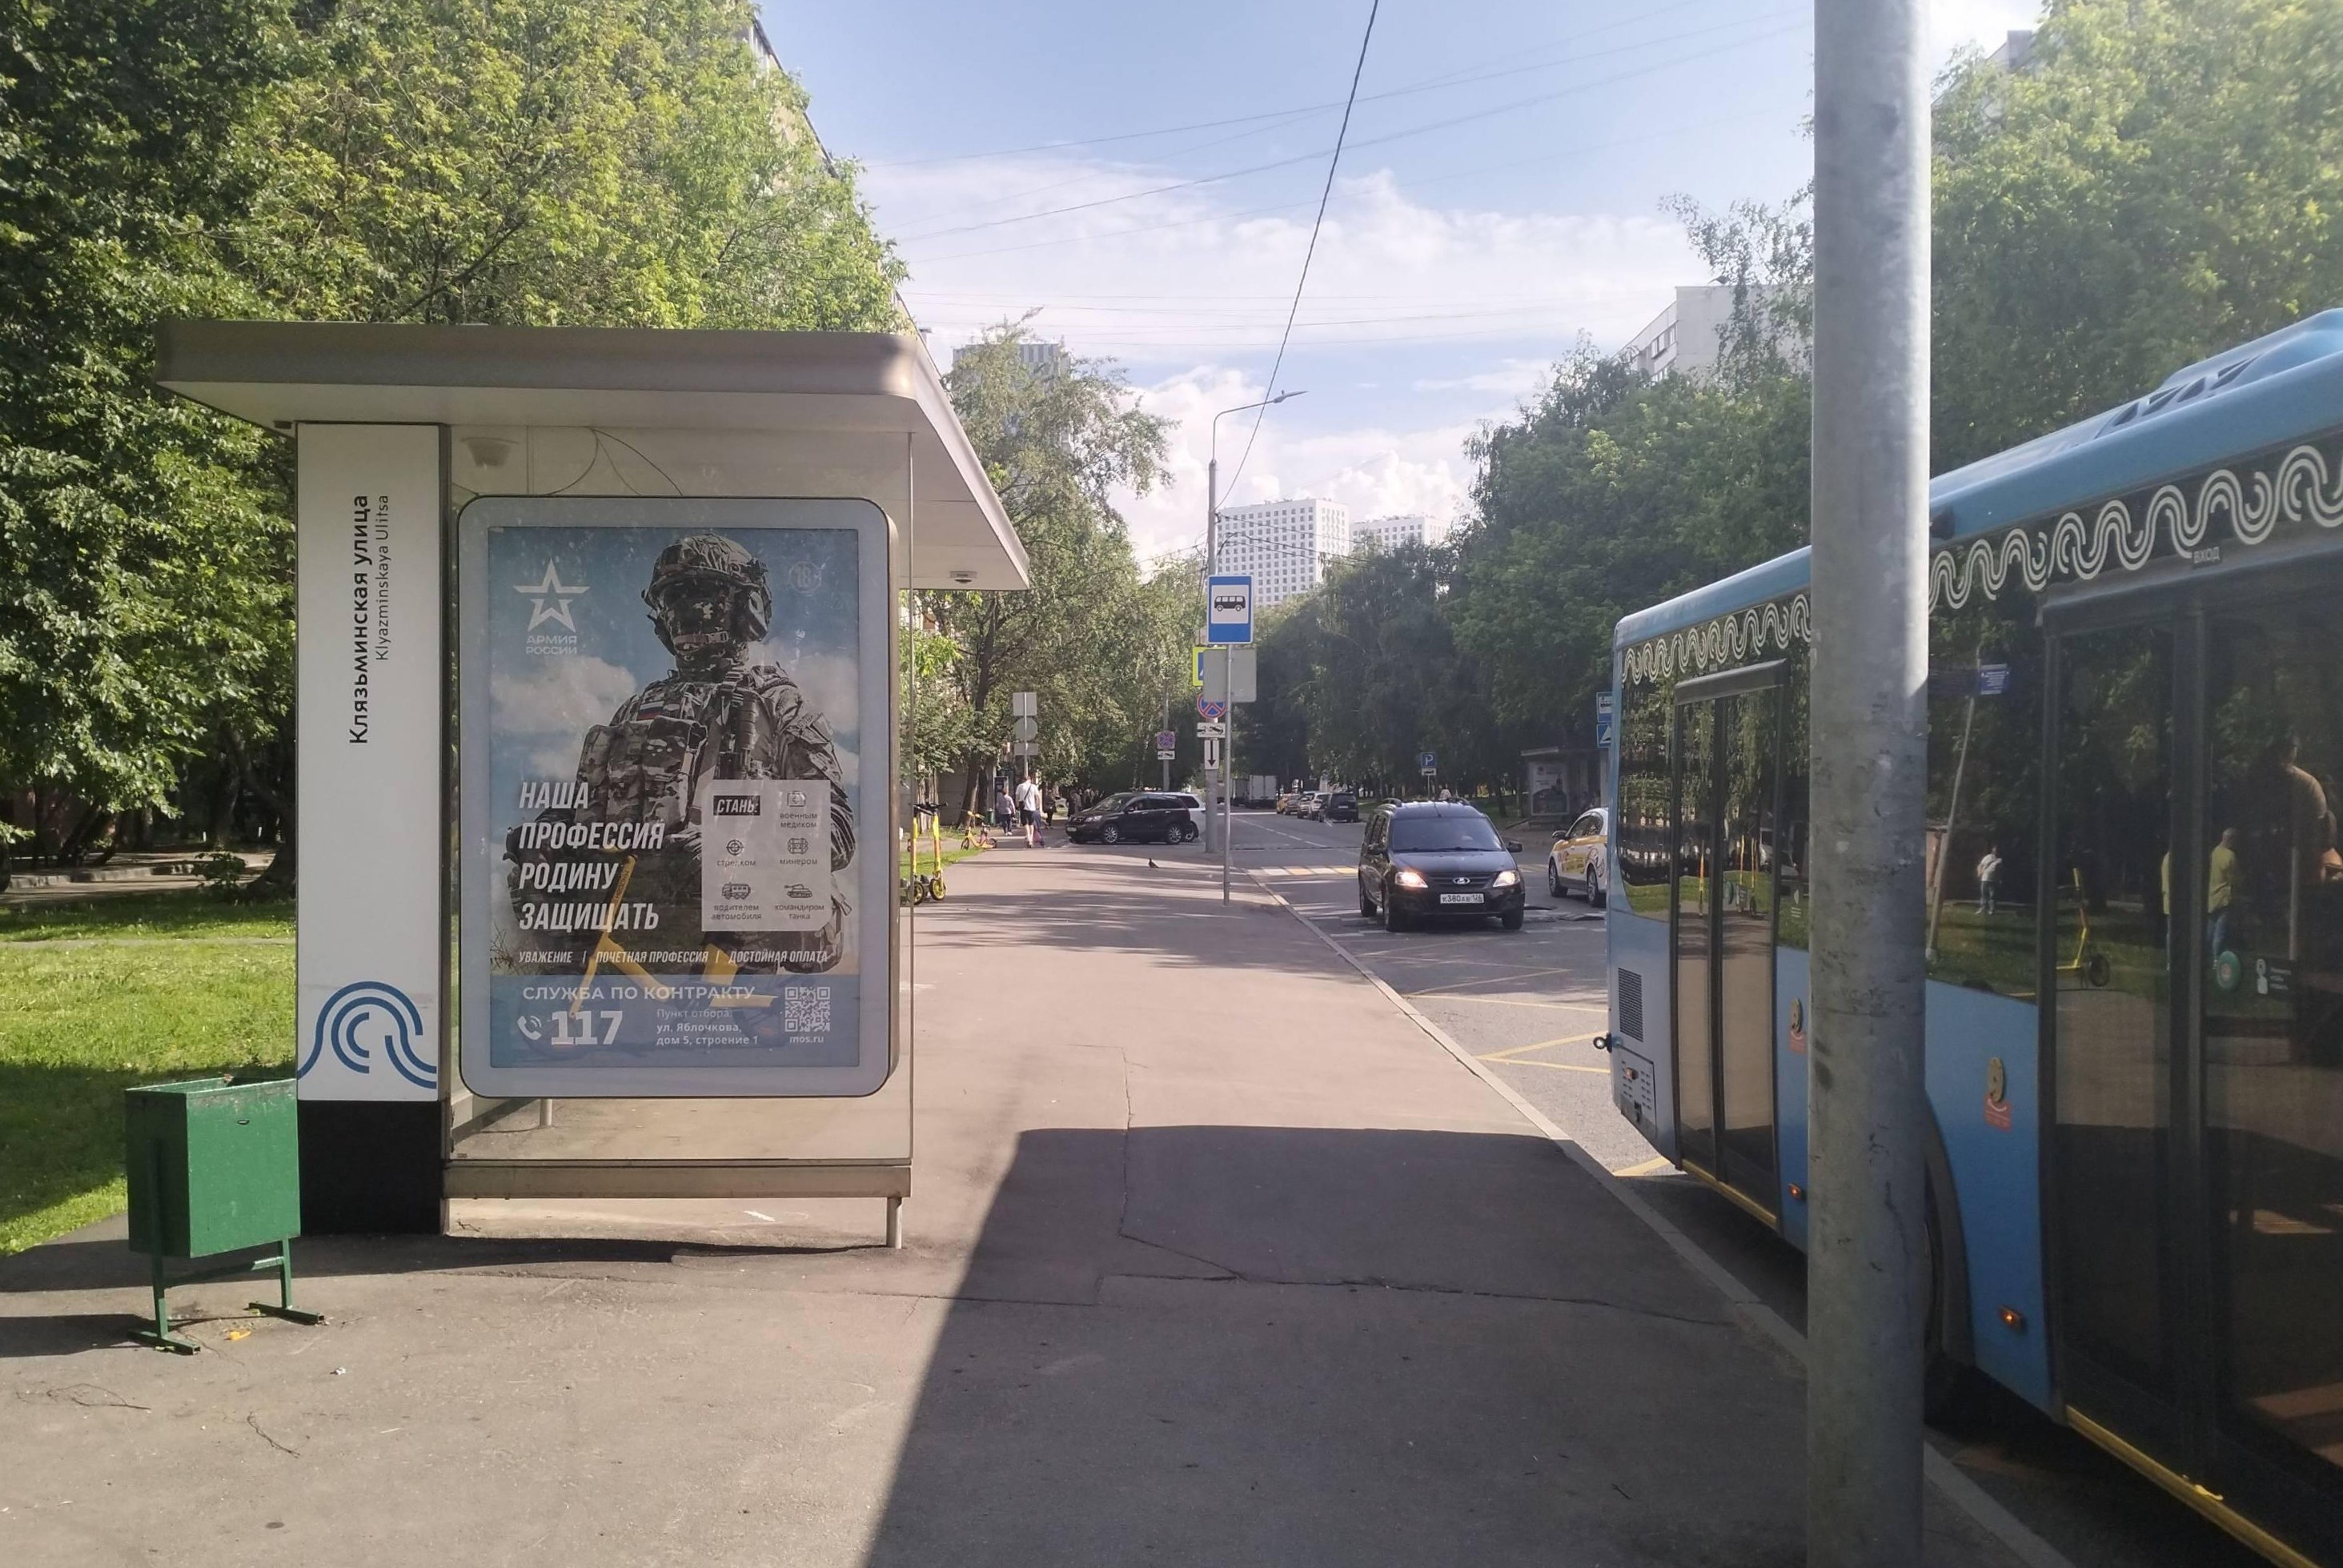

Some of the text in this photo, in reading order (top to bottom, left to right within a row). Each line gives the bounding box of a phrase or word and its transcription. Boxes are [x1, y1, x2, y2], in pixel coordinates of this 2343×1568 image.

[2194, 547, 2221, 563] ВХОД
[375, 495, 391, 660] Klyazminskaya Ulitsa
[349, 495, 372, 744] Клязьминская улица
[526, 635, 577, 644] АРМИЯ
[526, 646, 577, 655] РОССИИ
[519, 782, 588, 809] НАША
[716, 799, 760, 813] СТАНЬ:
[519, 821, 666, 849] ПРОФЕССИЯ
[519, 862, 620, 893] РОДИНУ
[519, 902, 660, 933] ЗАЩИЩАТЬ
[711, 912, 762, 920] автомобиля
[519, 949, 828, 964] УВАЖЕНИЕ ПОЧЕТНАЯ ПРОФЕССИЯ ДОСТОЙНАЯ ОПЛАТА
[522, 986, 756, 1001] СЛУЖБА ПО КОНТРАКТУ
[656, 1009, 688, 1020] Пункт
[551, 1010, 624, 1045] 117
[656, 1022, 742, 1034] ул. Яблочкова,
[656, 1035, 759, 1046] дом 5, строение 1
[789, 1035, 824, 1045] mos.ru
